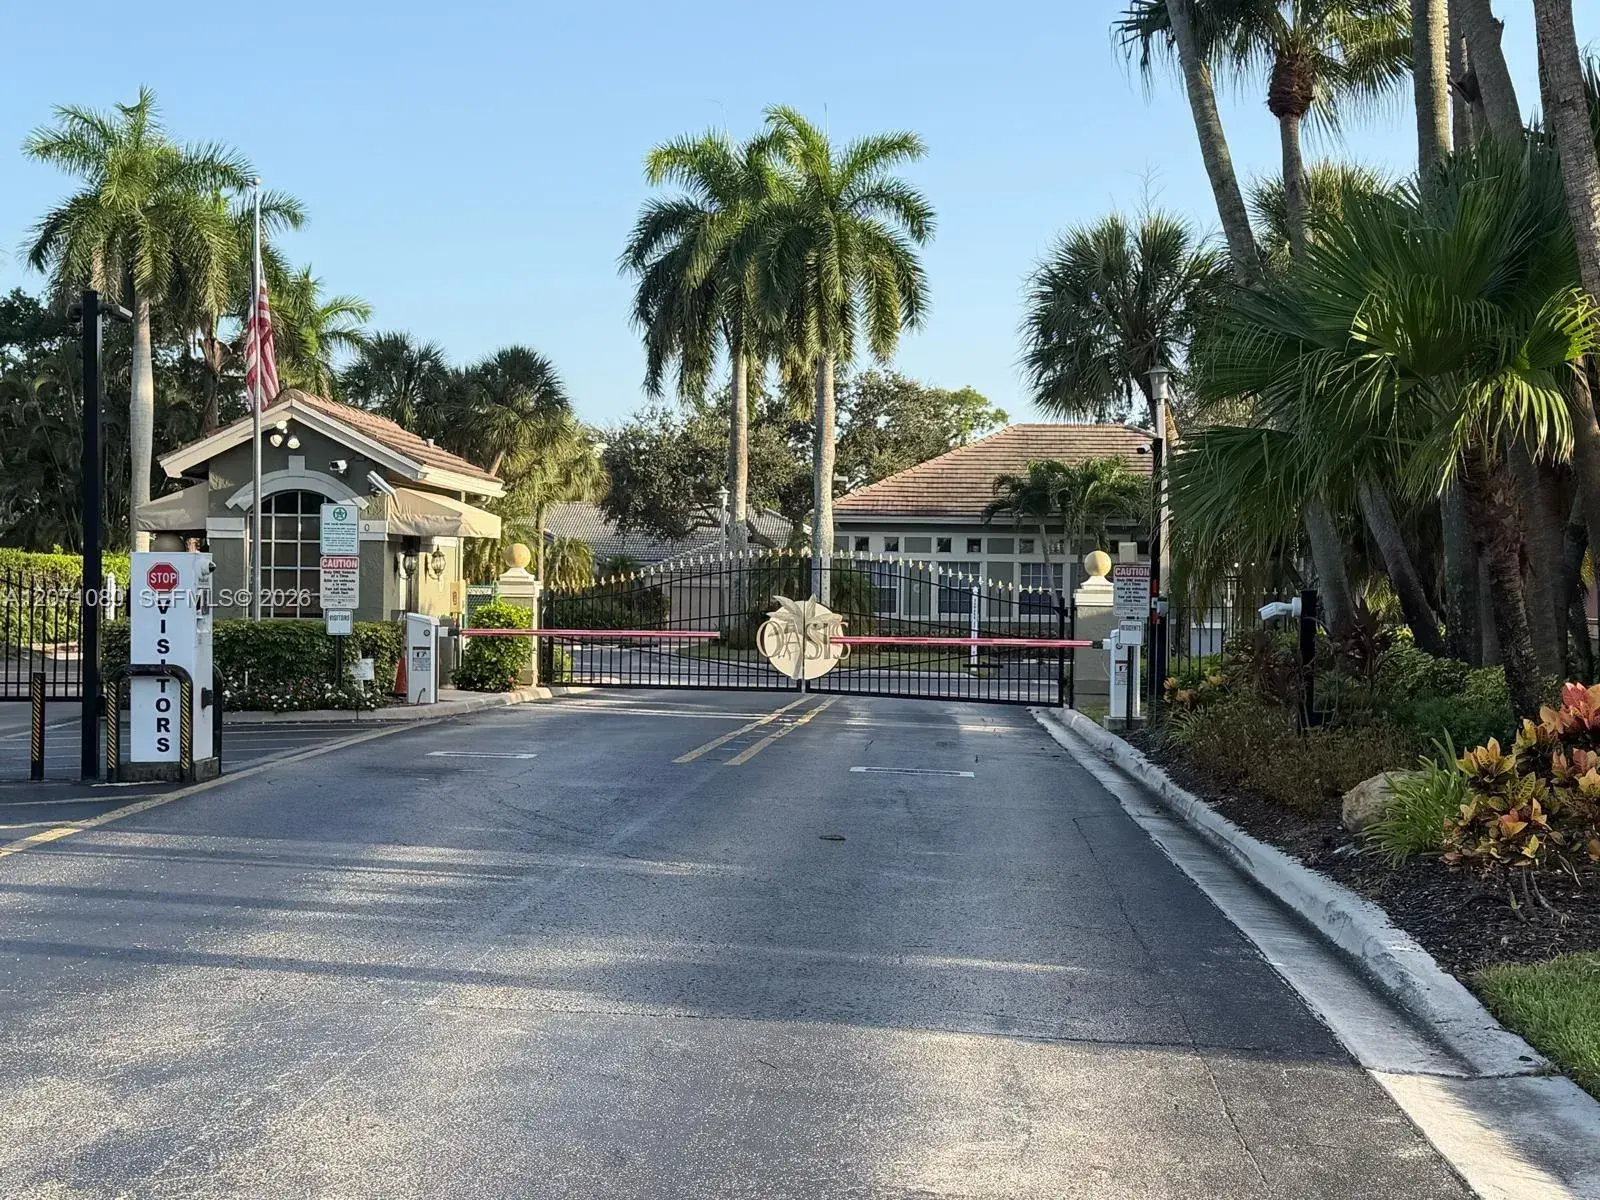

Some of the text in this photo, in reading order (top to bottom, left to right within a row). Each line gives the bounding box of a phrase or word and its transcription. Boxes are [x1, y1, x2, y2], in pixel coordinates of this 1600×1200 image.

[322, 558, 358, 569] CAUTION
[1115, 567, 1150, 577] CAUTION
[150, 573, 177, 584] STOP
[756, 620, 851, 660] OASIS
